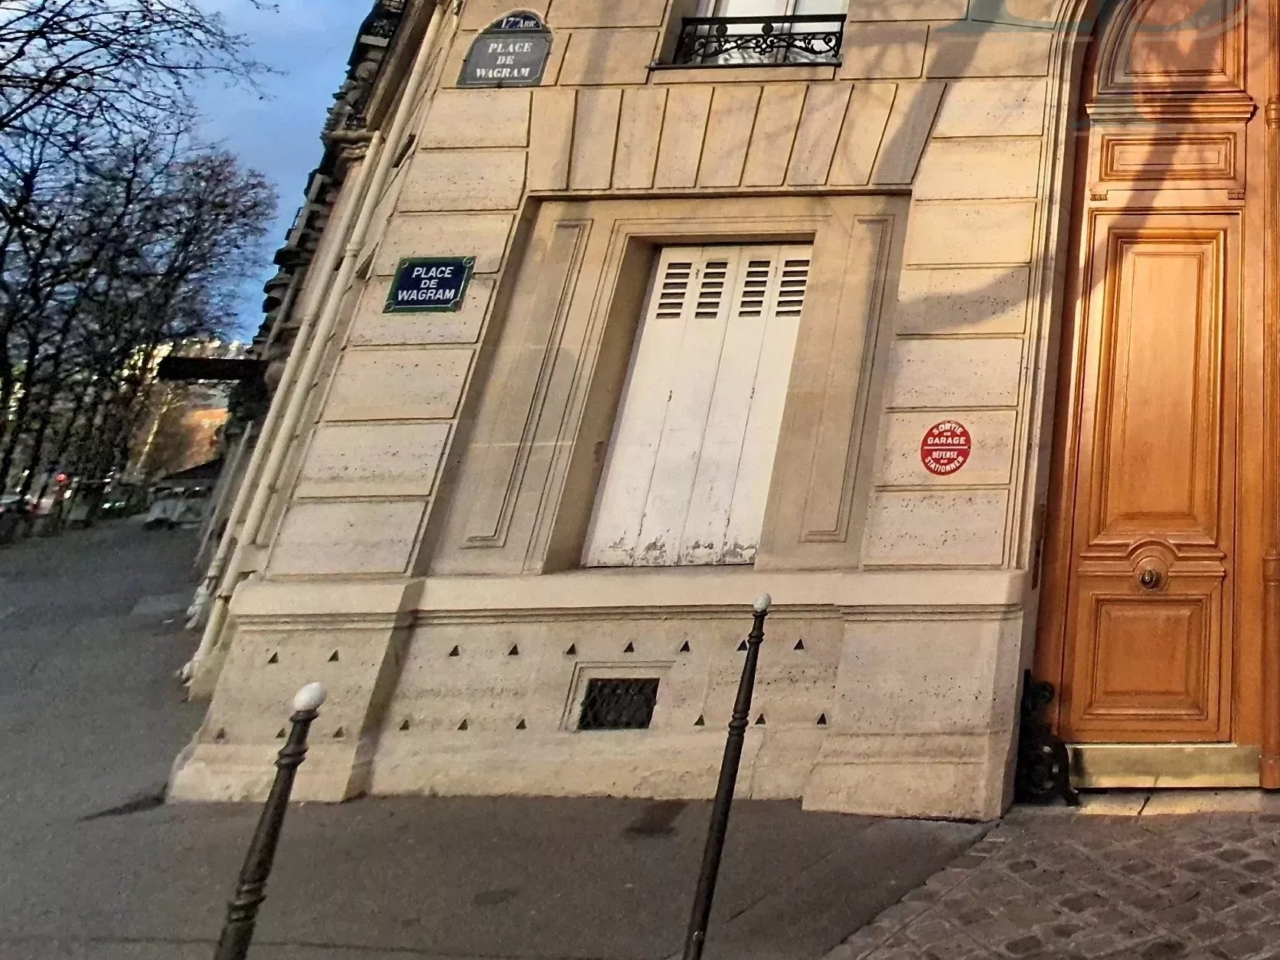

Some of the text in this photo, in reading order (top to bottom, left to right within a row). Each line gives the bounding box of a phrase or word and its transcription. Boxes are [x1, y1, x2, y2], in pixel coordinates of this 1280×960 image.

[488, 42, 533, 54] PLACE
[496, 55, 515, 65] DE
[475, 67, 530, 78] WAGRAM
[412, 266, 454, 278] PLACE
[420, 279, 439, 288] DE
[398, 289, 455, 301] WAGRAM
[932, 423, 964, 435] SORTIE
[927, 436, 966, 445] GARAGE
[925, 456, 964, 473] STATIONNER
